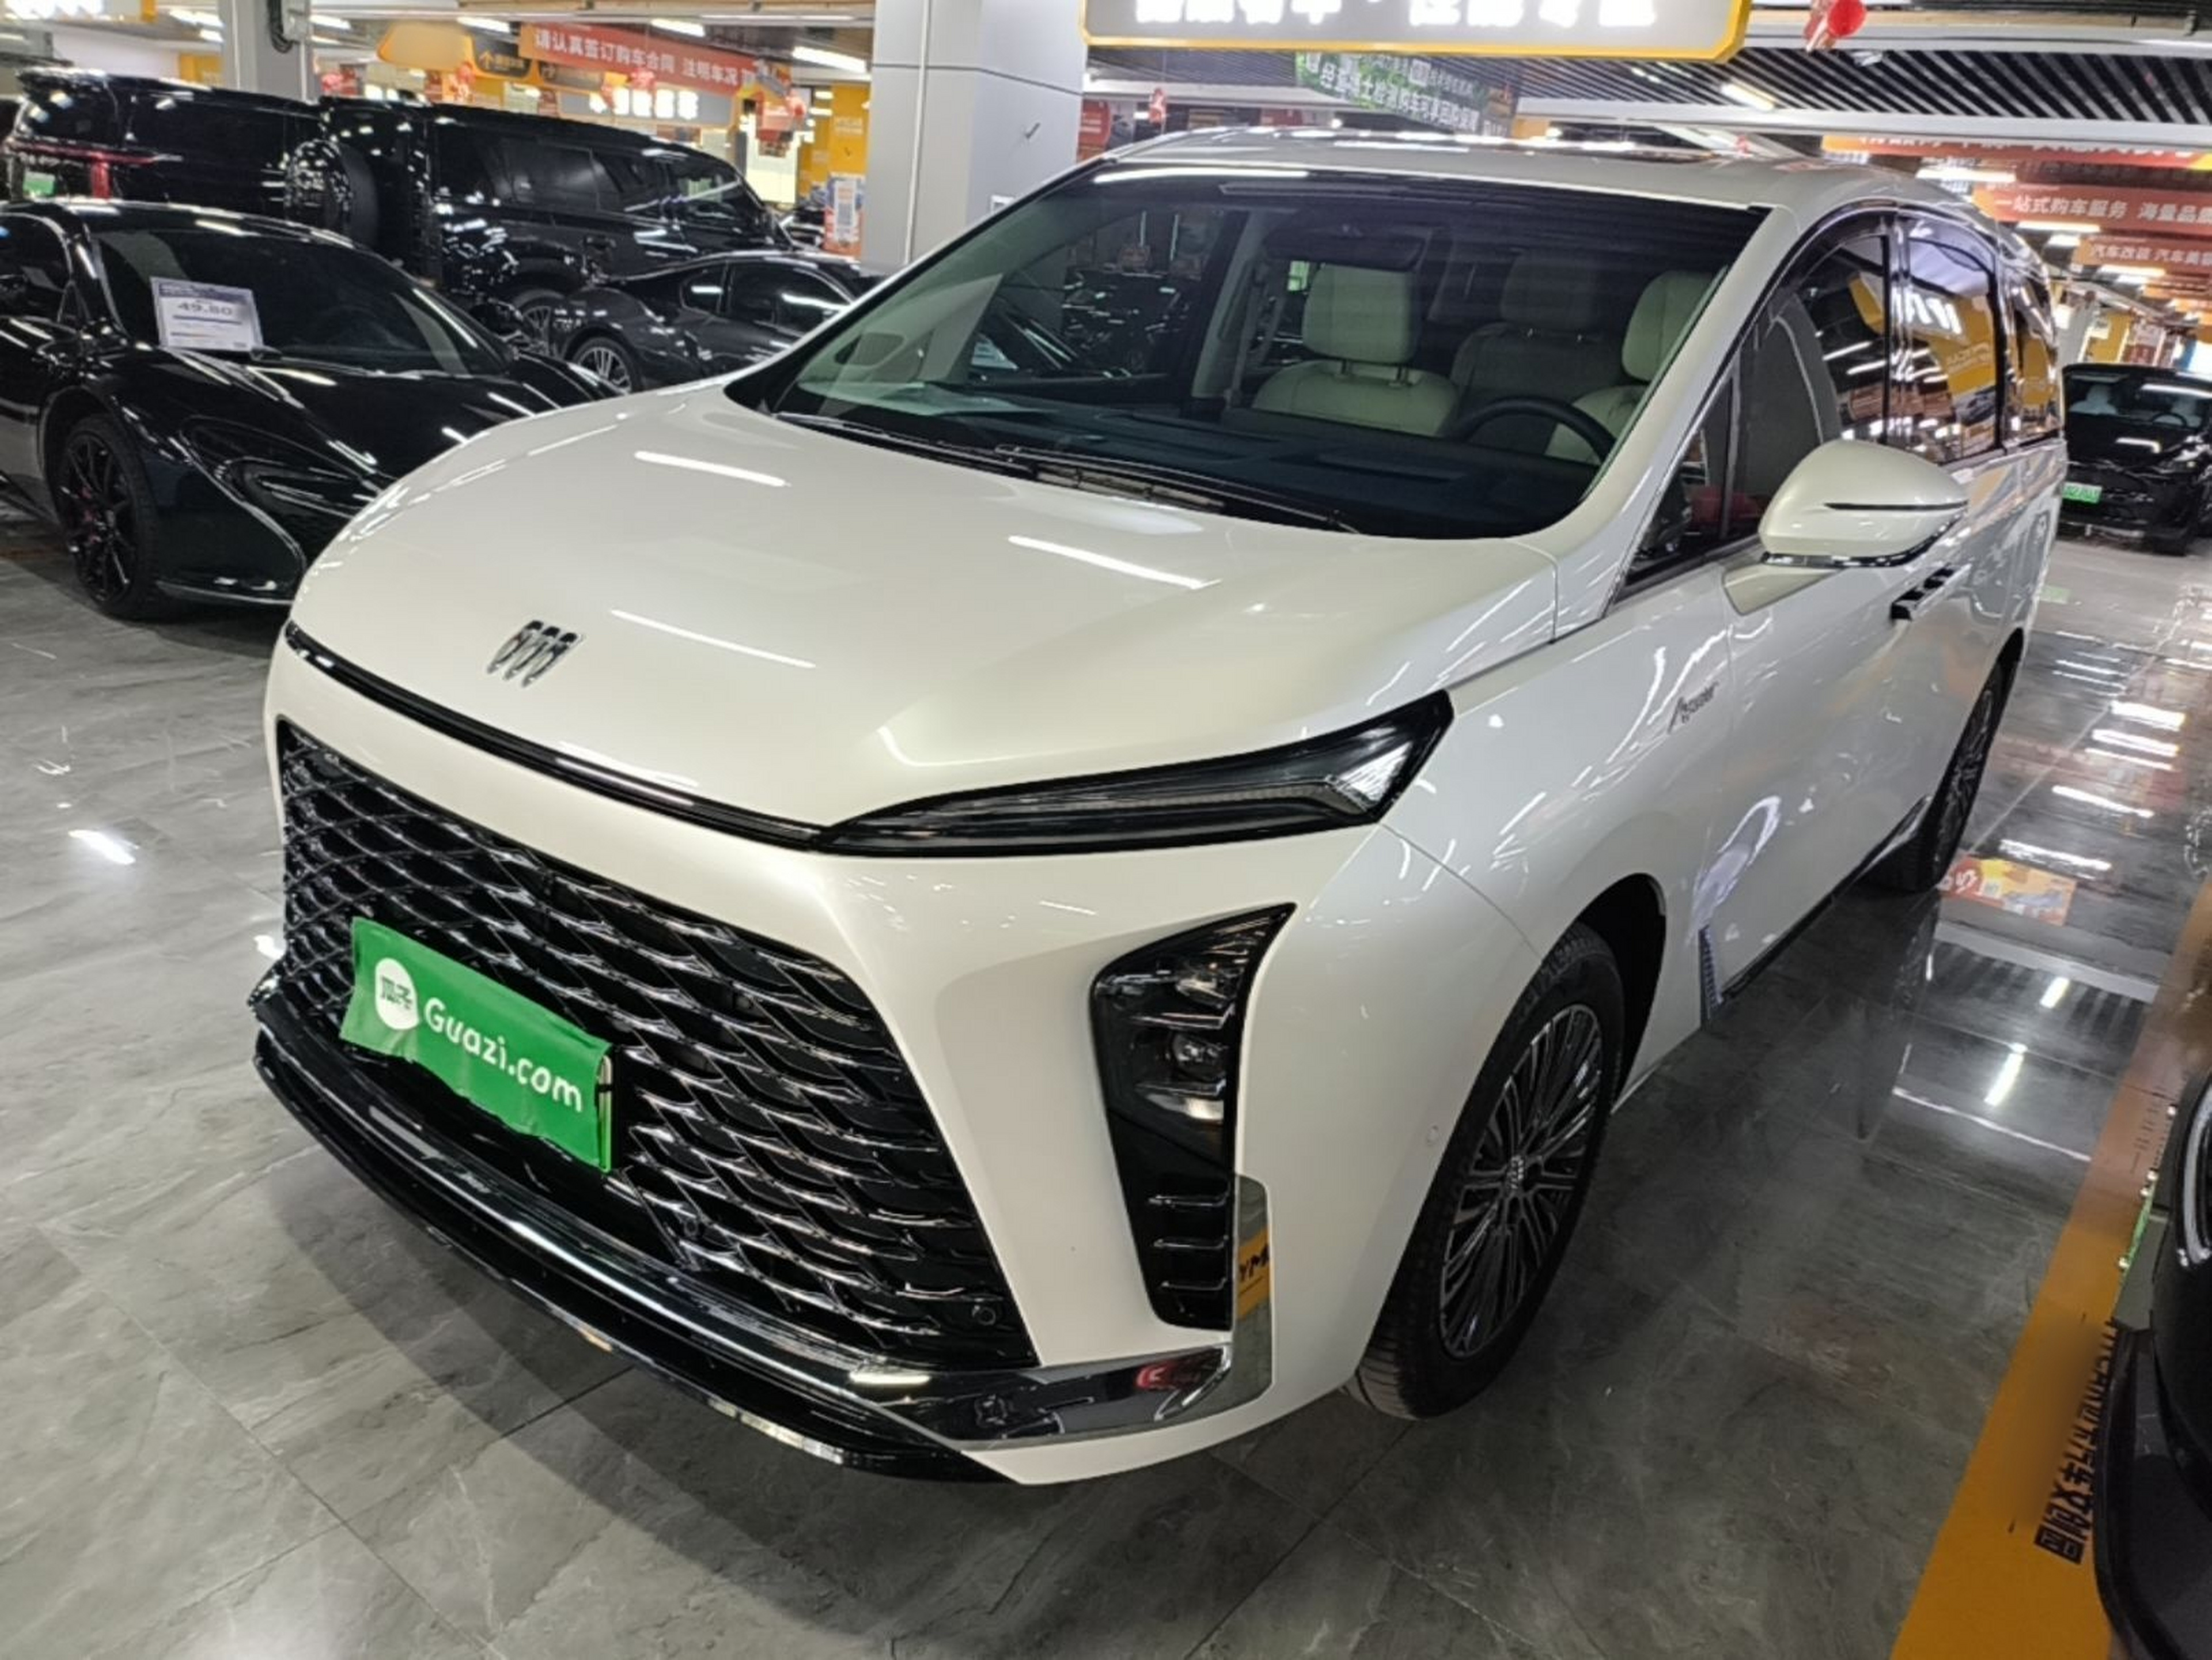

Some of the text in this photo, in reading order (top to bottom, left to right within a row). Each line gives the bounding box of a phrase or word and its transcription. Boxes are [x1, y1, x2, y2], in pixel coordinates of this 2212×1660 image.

[536, 28, 675, 74] 请认真签订购车合同
[1995, 194, 2128, 219] 一站式购车服务
[2092, 243, 2152, 260] 汽车改装
[424, 997, 583, 1113] Guazi.com
